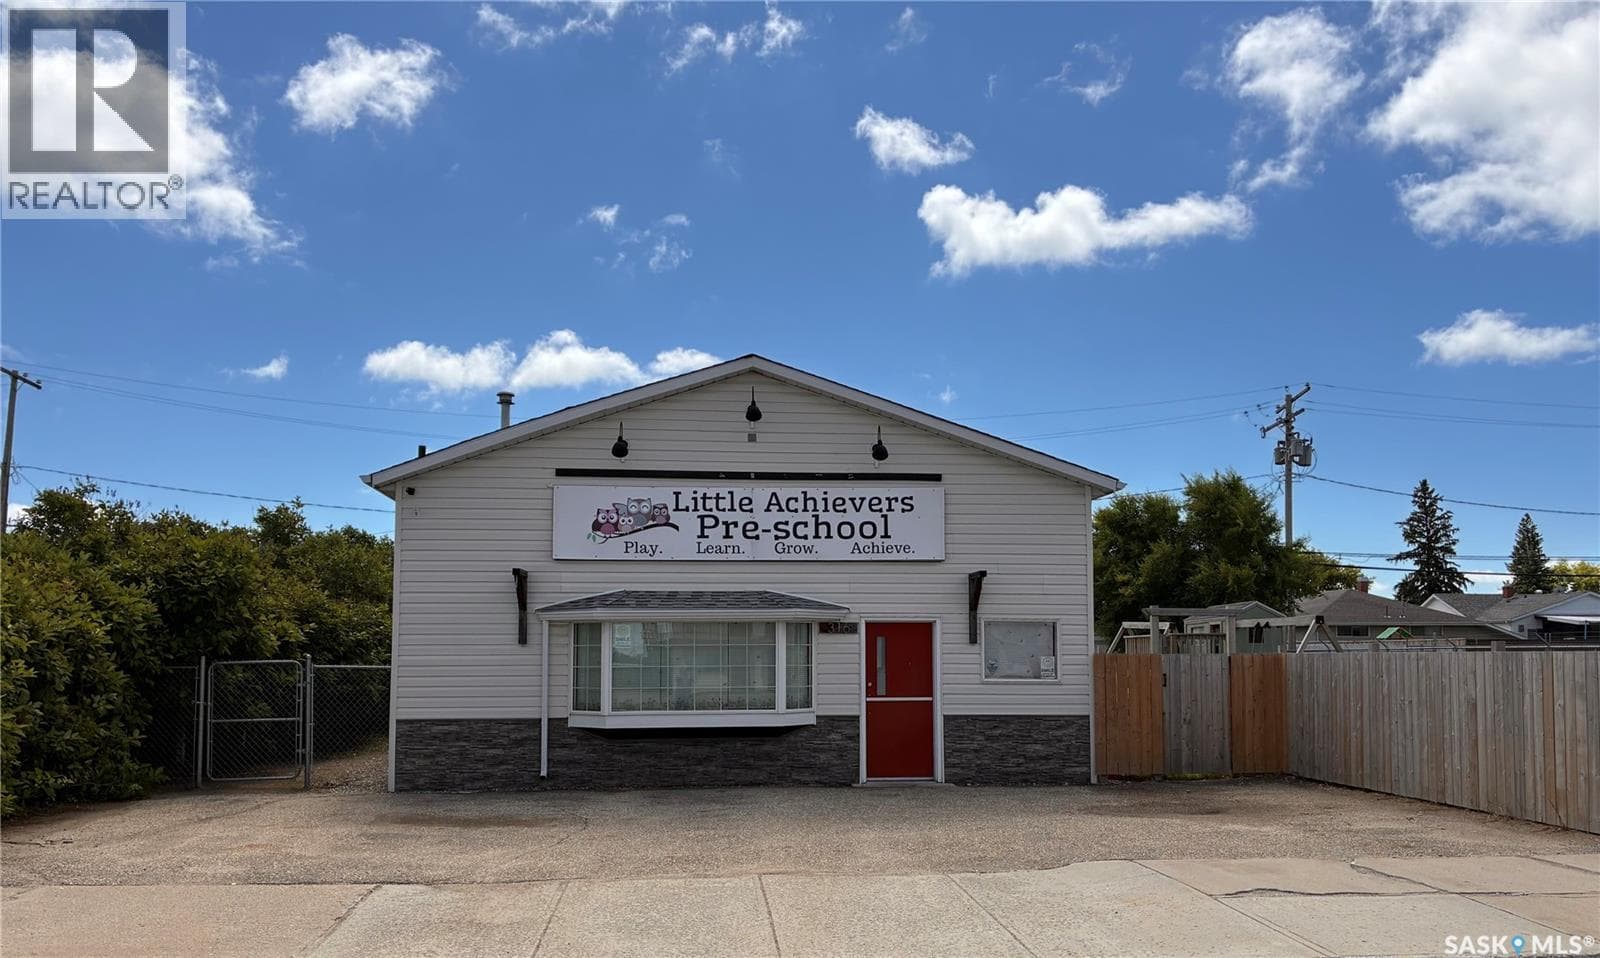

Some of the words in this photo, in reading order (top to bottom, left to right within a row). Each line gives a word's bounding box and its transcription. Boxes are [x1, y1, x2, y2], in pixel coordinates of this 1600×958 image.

[672, 490, 754, 513] Little
[763, 490, 915, 514] Achievers
[696, 514, 892, 541] Pre-school
[623, 541, 663, 557] Play.
[695, 541, 745, 555] Learn.
[774, 541, 819, 555] Grow.
[850, 541, 915, 555] Achieve.
